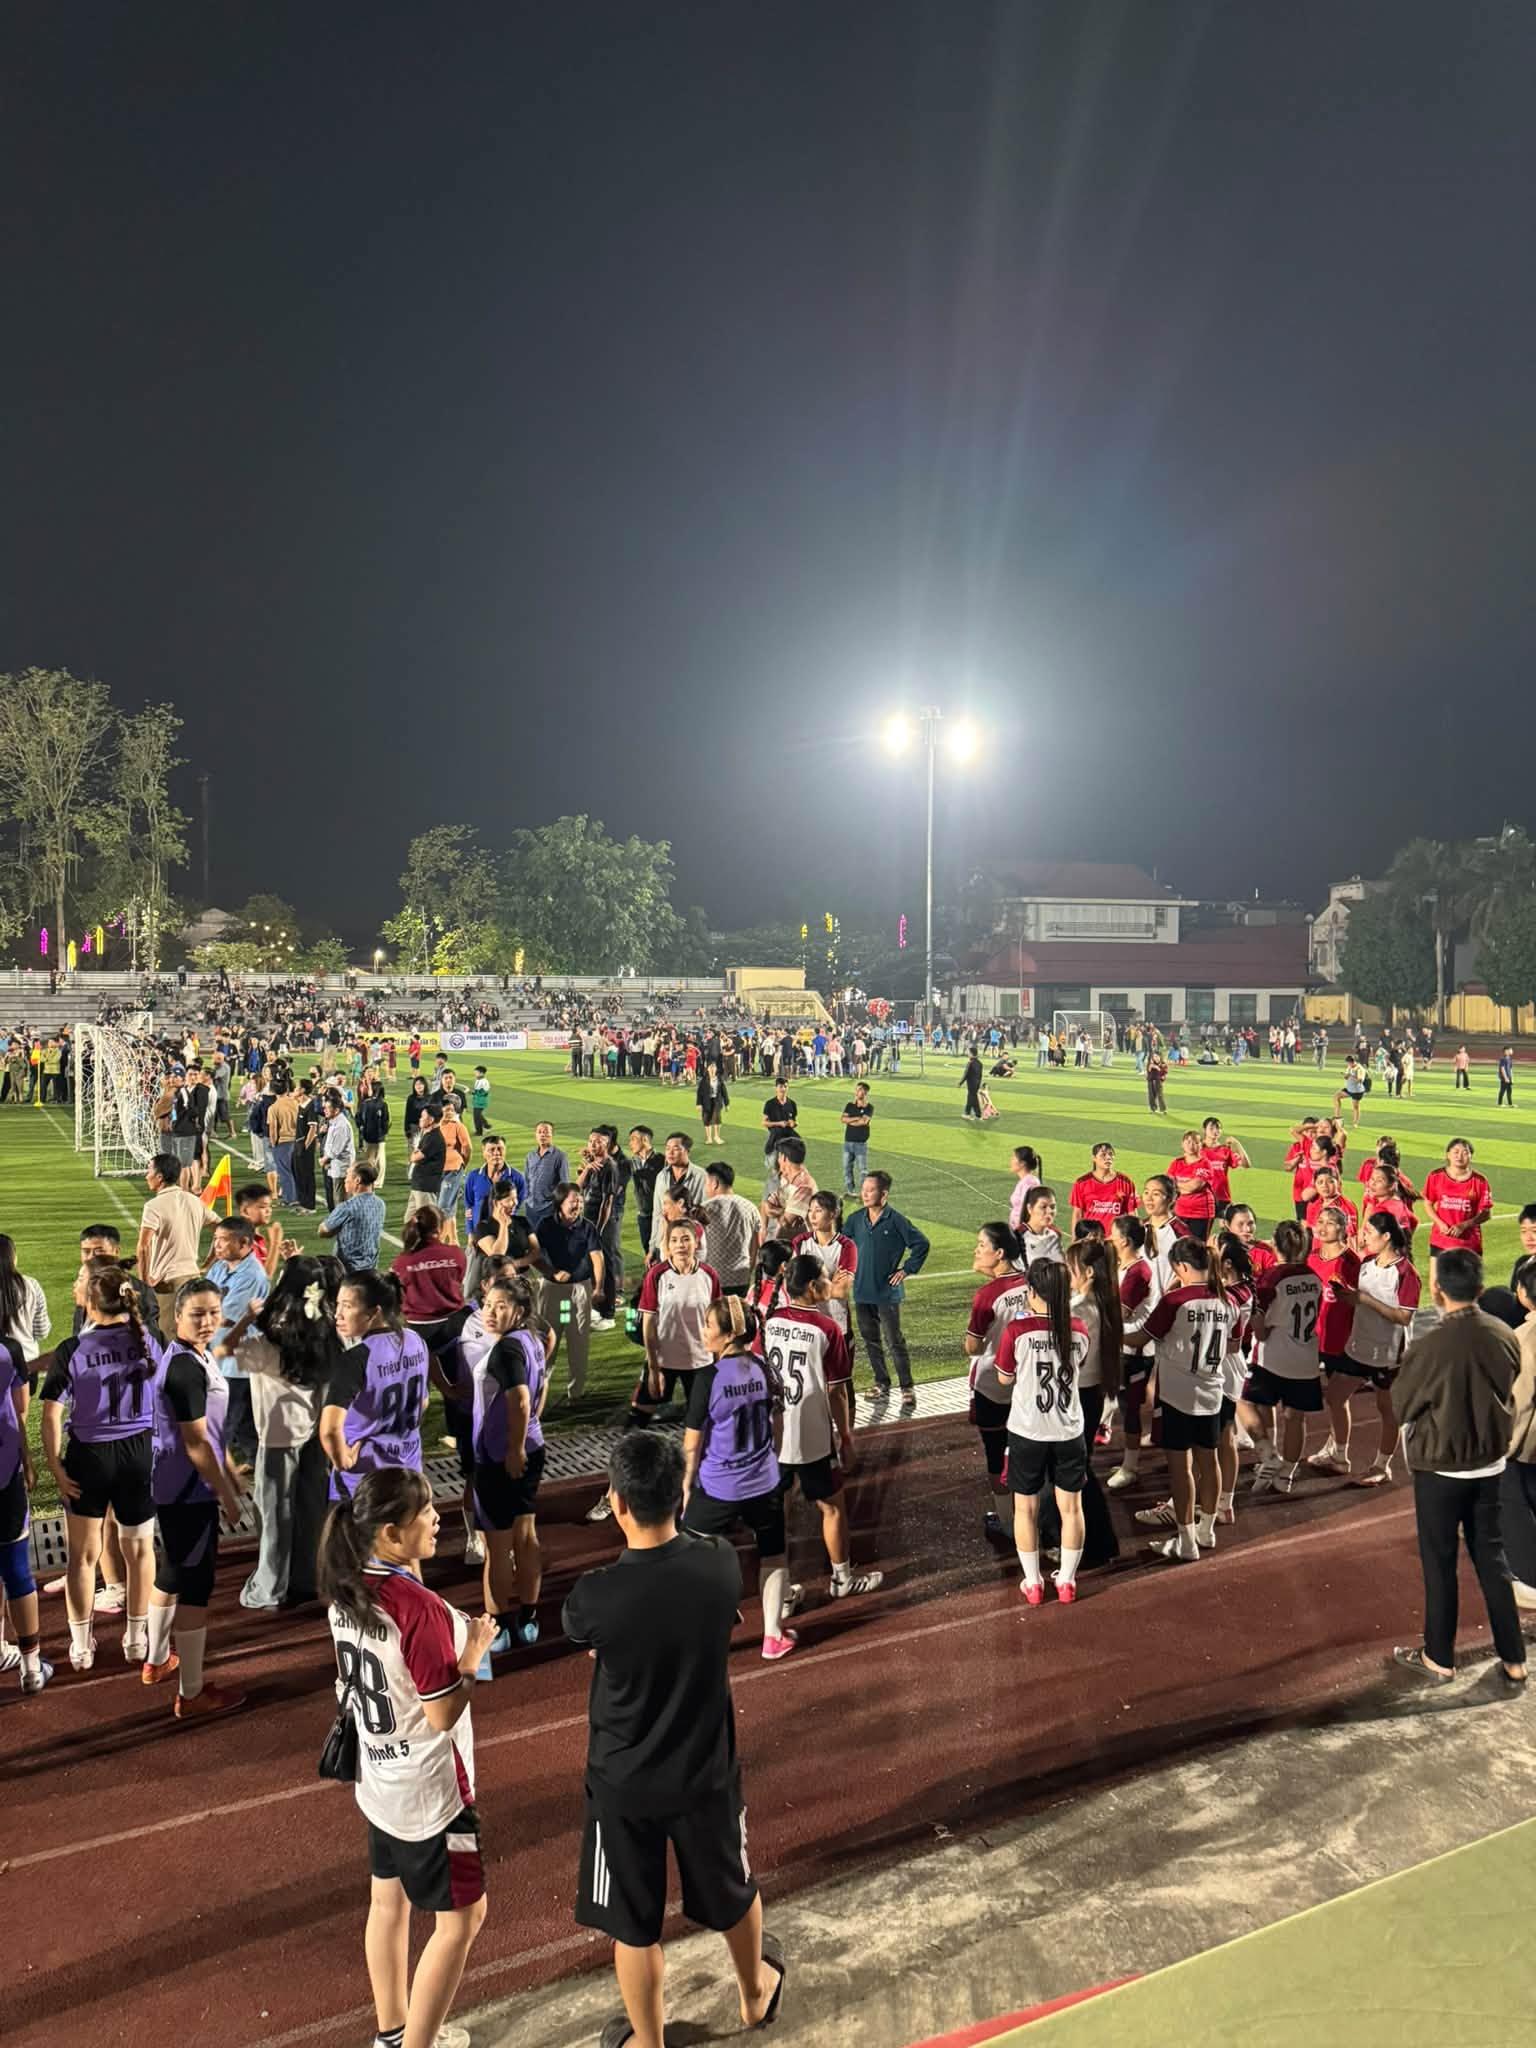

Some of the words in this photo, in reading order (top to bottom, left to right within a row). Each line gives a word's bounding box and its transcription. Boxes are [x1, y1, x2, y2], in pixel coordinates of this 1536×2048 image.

[1290, 1301, 1317, 1343] 12
[86, 1350, 122, 1369] Linh
[1190, 1329, 1222, 1374] 14
[1036, 1361, 1074, 1414] 38
[399, 1739, 410, 1757] 5
